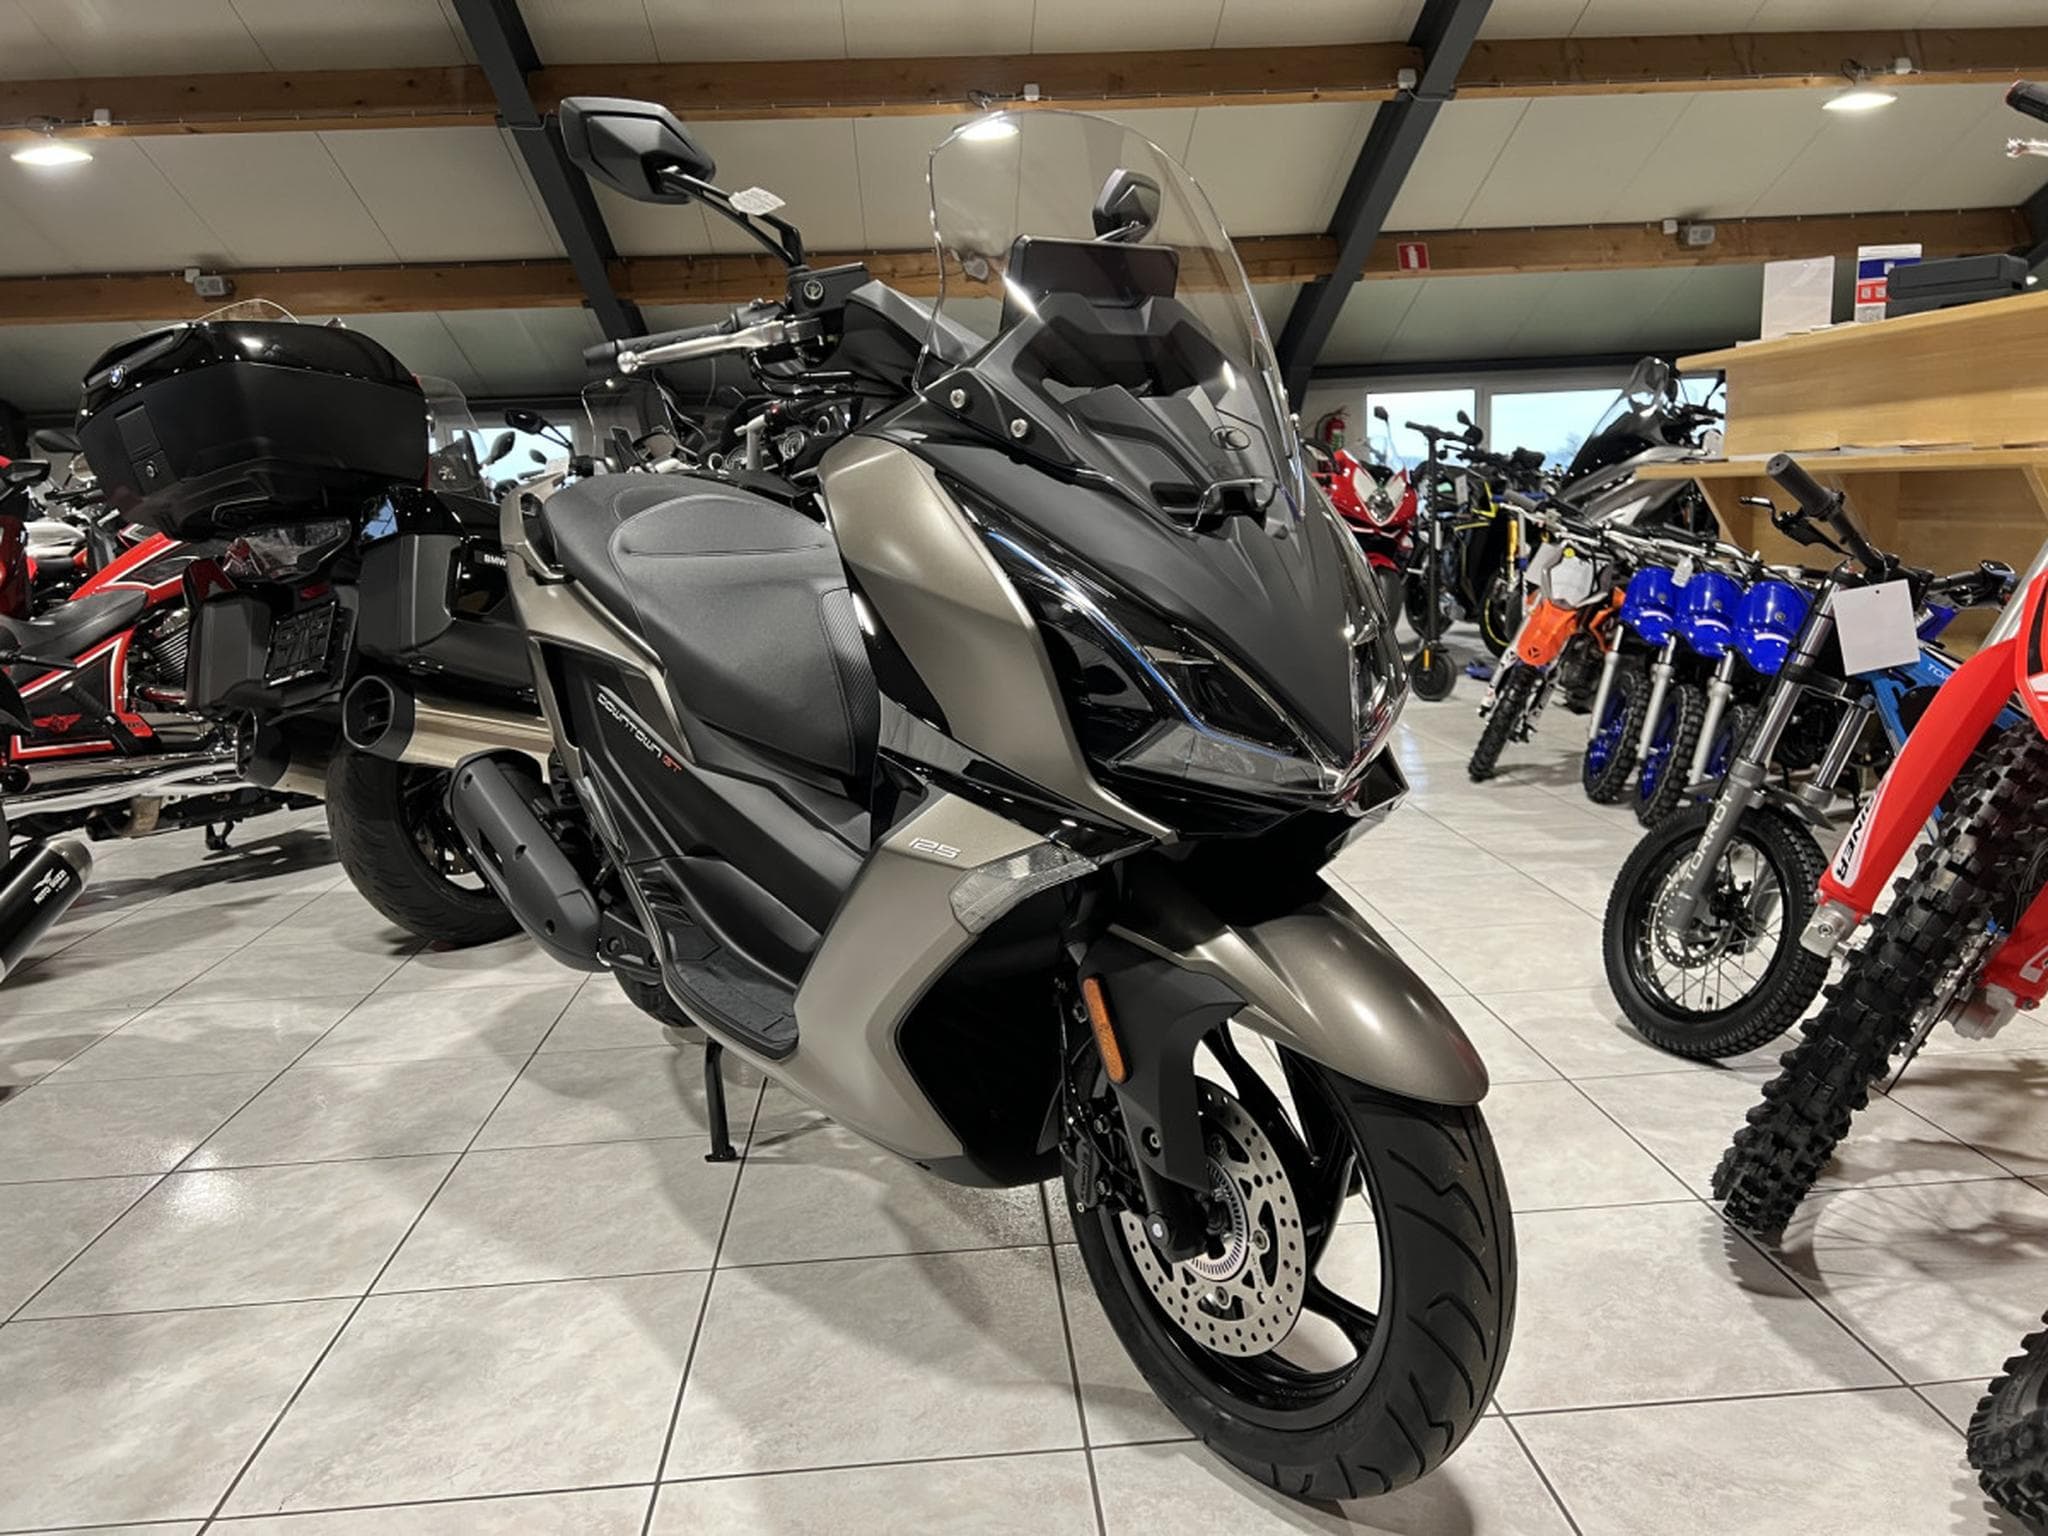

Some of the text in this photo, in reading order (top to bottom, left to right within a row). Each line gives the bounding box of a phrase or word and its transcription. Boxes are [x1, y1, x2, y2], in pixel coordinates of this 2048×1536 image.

[484, 554, 506, 566] BMW
[597, 692, 682, 772] DOWNTOWN GT
[908, 837, 961, 858] 125
[1683, 789, 1732, 880] TORROT
